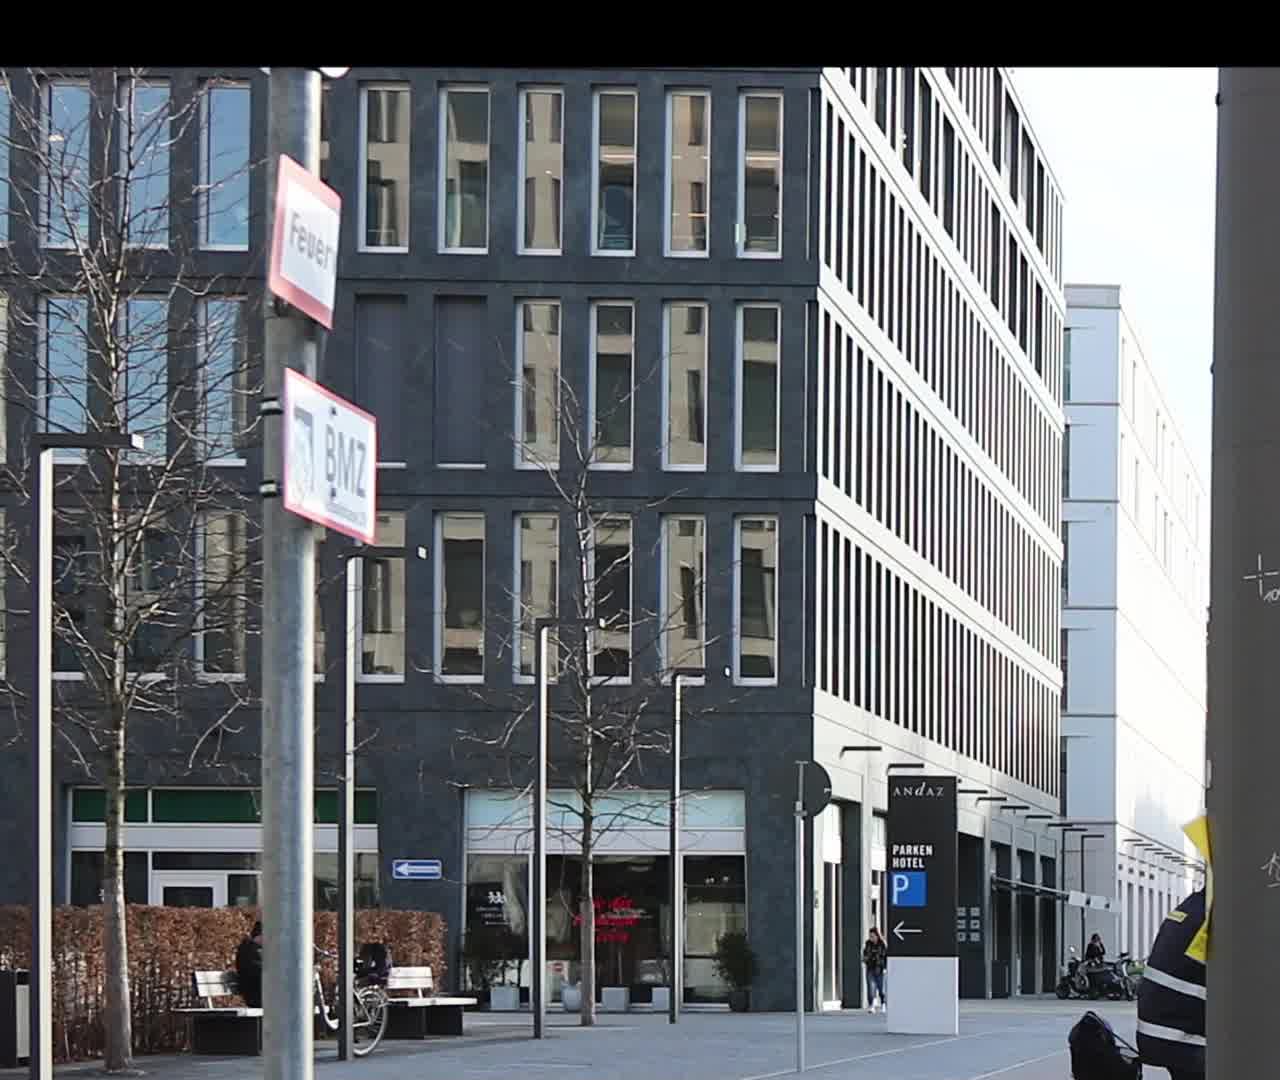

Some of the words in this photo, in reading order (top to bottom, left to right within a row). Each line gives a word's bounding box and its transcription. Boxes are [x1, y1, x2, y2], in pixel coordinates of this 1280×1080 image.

[289, 210, 333, 267] Feuer
[325, 423, 367, 498] BMZ
[892, 844, 933, 857] PARKEN
[892, 857, 925, 869] HOTEL
[892, 874, 909, 905] P
